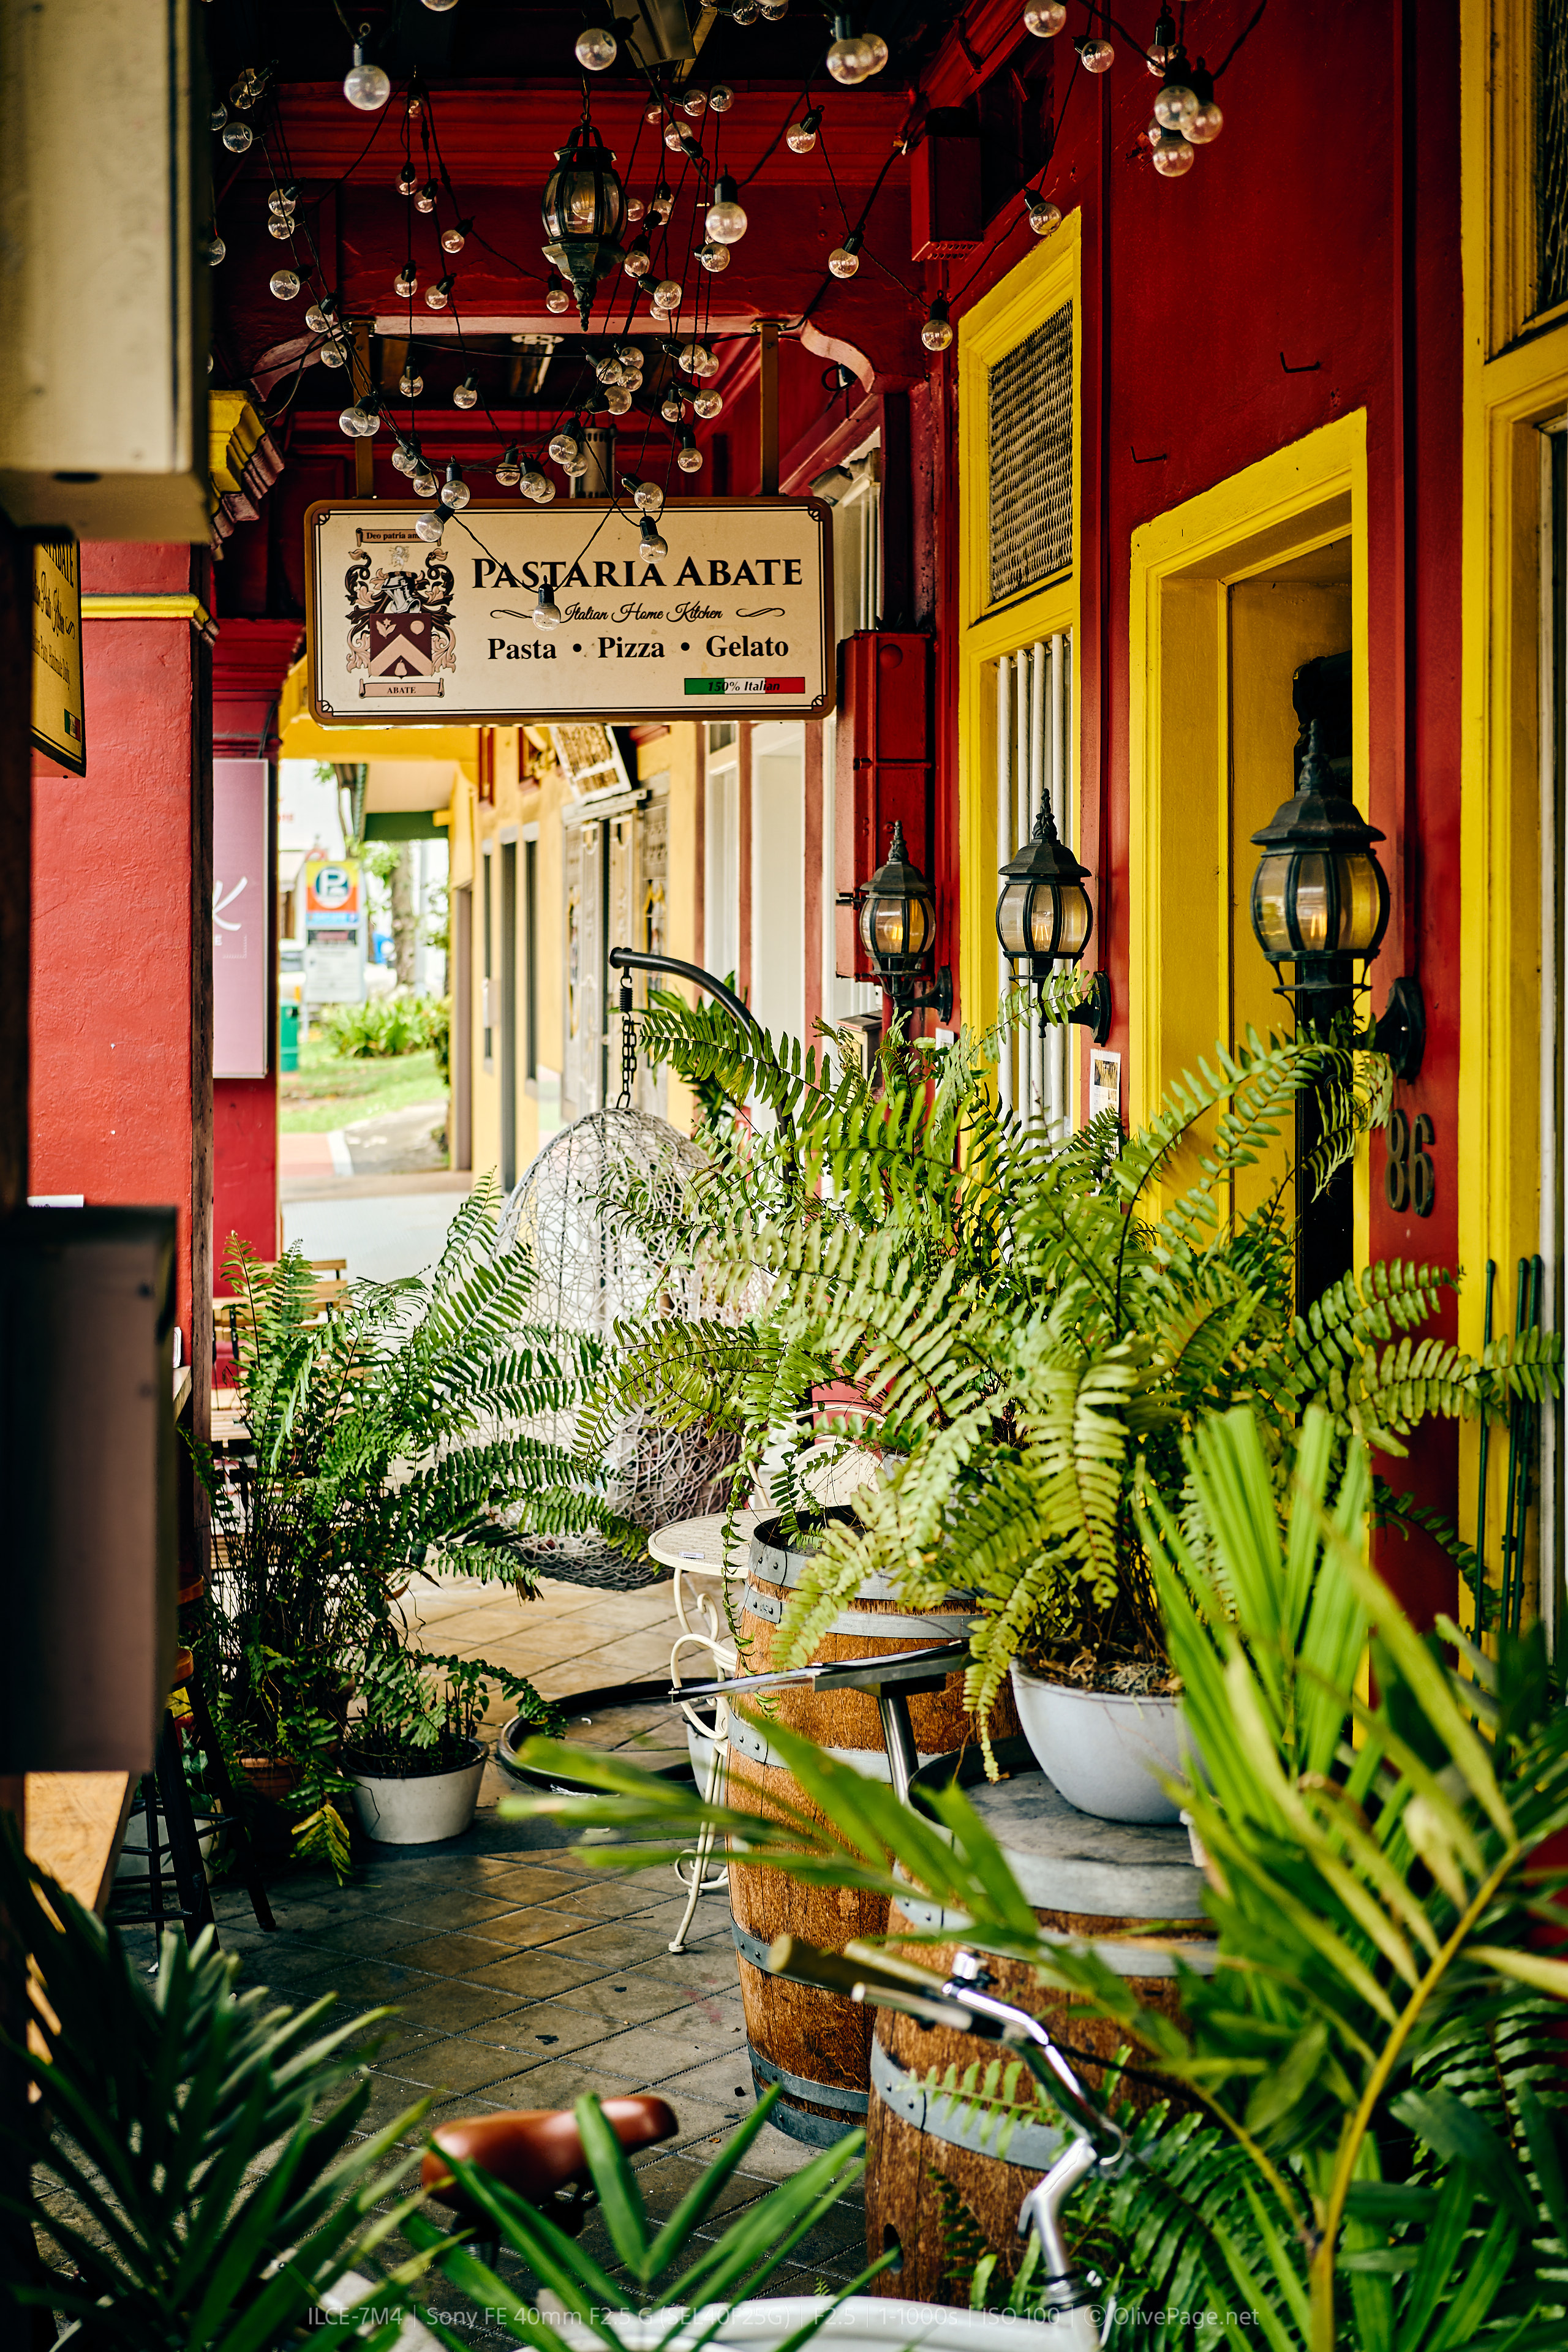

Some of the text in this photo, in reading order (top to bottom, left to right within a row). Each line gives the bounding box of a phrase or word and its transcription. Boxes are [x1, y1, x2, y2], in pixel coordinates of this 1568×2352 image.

[383, 532, 405, 541] patria
[472, 556, 802, 588] PASTARIA ABATE
[559, 600, 723, 623] Italian Home Kitchen
[487, 635, 789, 660] Pasta Pizza Gelato
[708, 680, 780, 692] 150% Italian
[1384, 1109, 1435, 1218] 86
